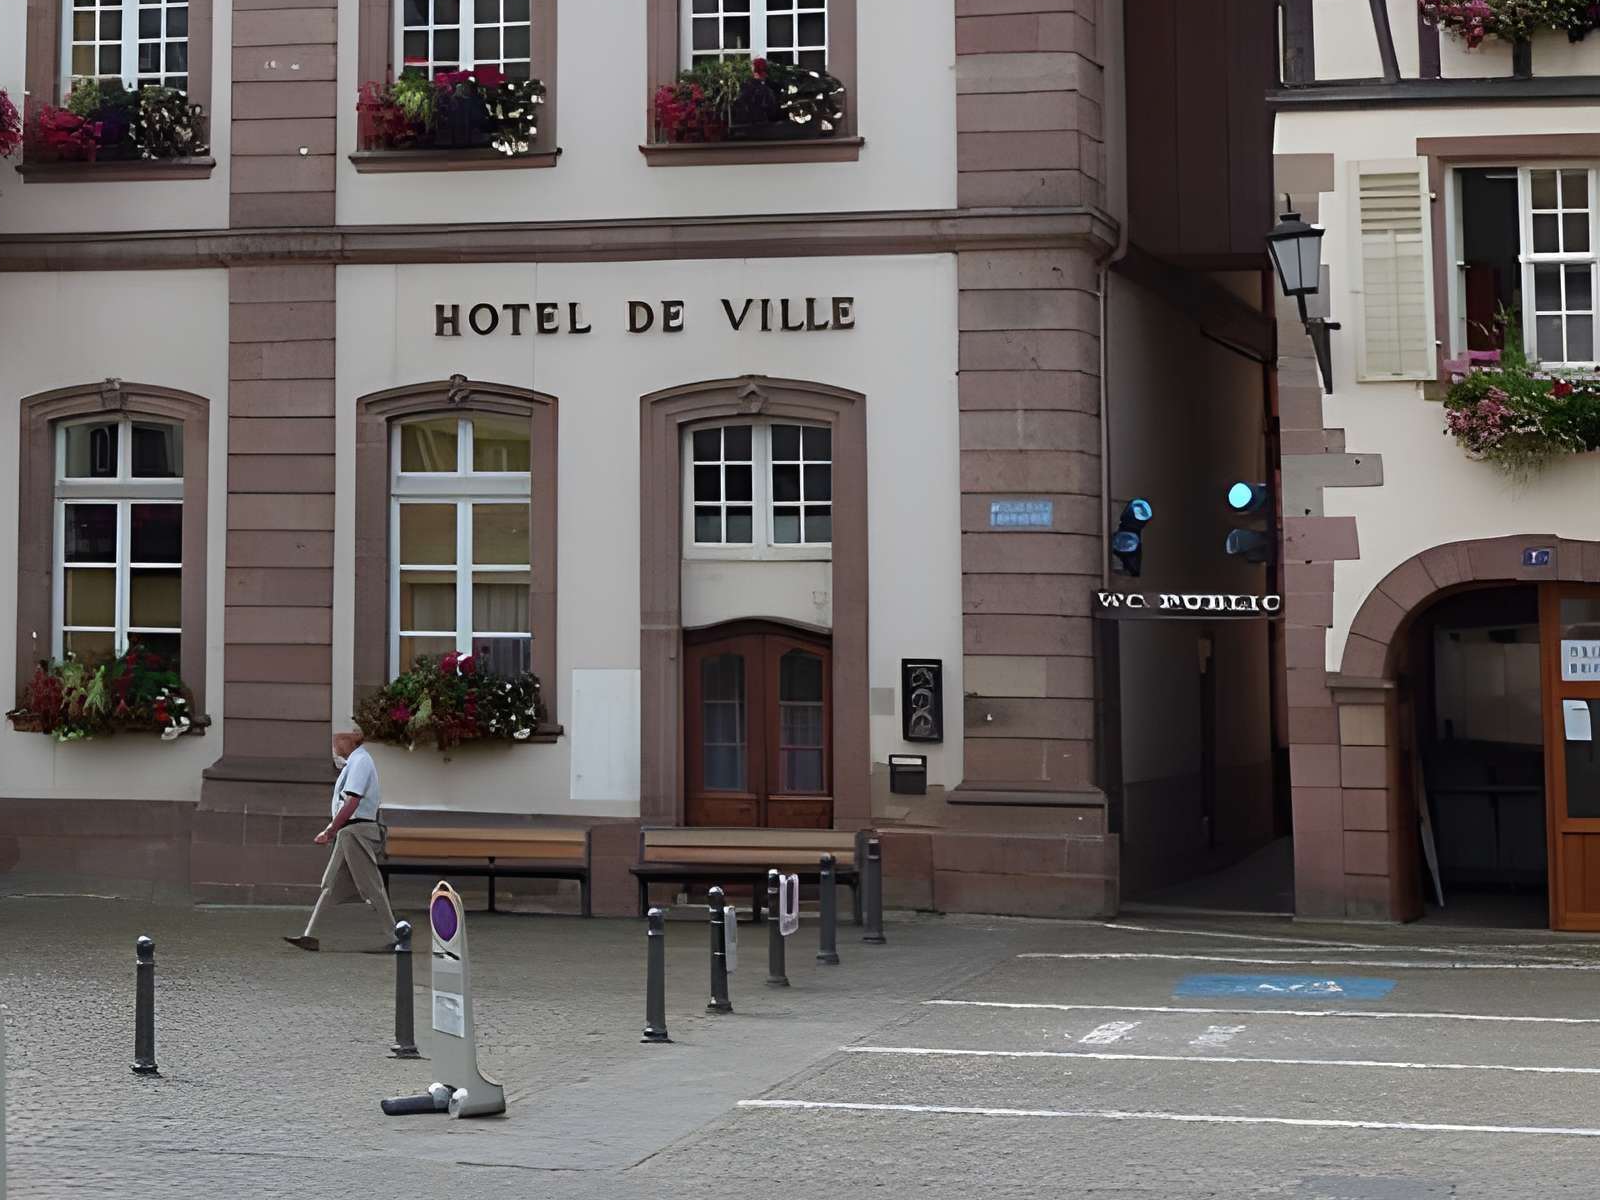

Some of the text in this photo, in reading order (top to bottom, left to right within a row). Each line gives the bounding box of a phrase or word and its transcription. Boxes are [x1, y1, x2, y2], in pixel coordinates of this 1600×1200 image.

[435, 296, 855, 337] HOTEL DE VILLE
[1098, 592, 1145, 608] WC
